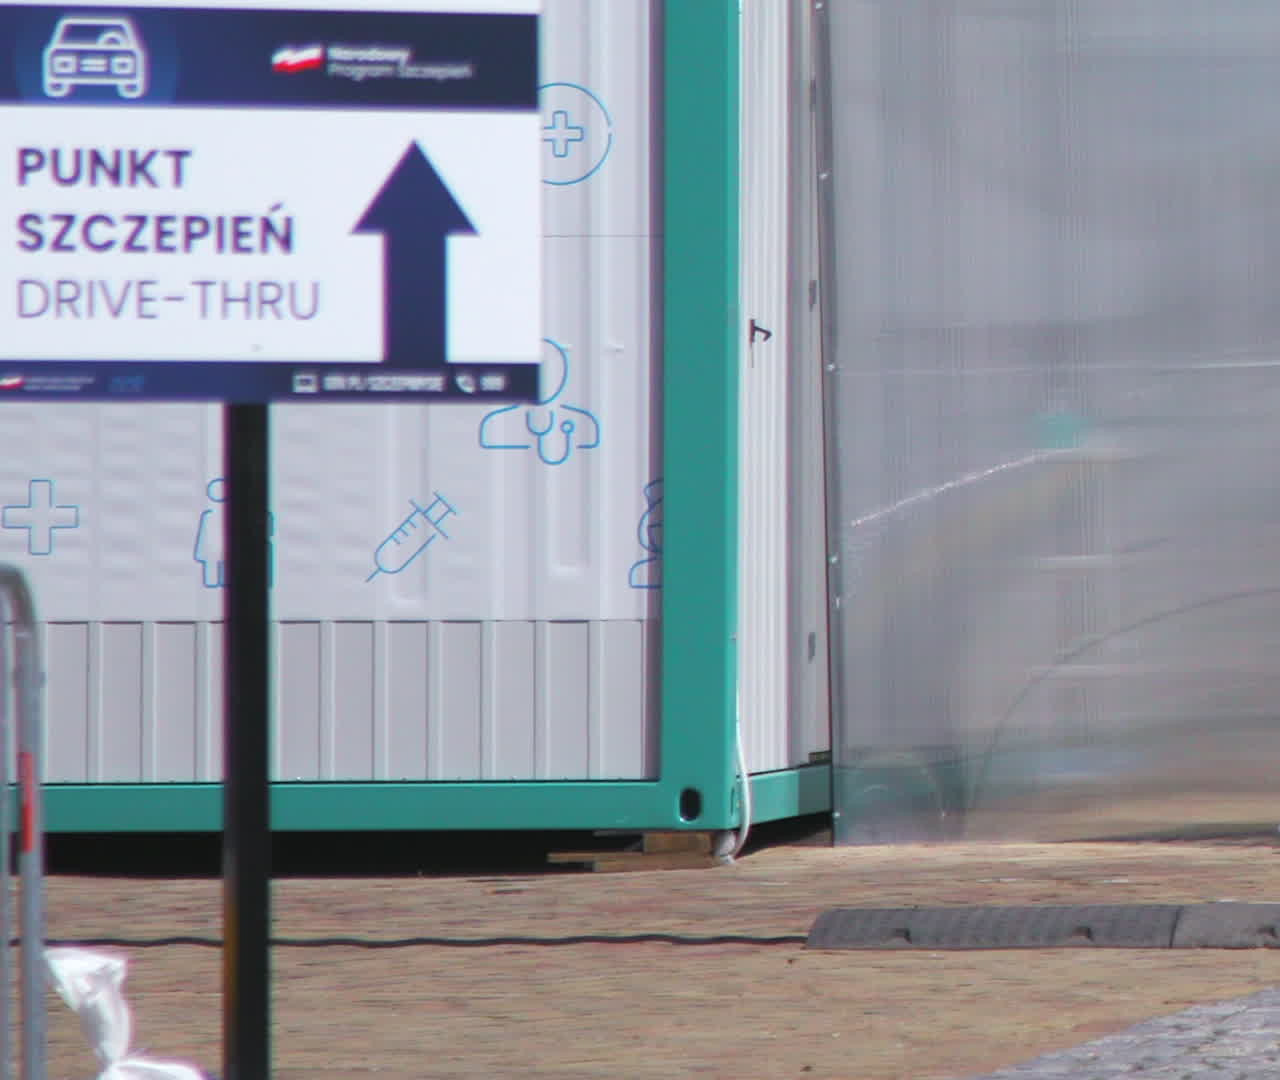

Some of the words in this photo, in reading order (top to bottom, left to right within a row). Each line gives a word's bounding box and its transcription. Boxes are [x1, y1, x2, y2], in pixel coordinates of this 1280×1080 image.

[16, 147, 192, 188] PUNKT
[16, 202, 295, 254] SZCZEPIEŃ
[16, 278, 321, 321] DRIVE-THRU
